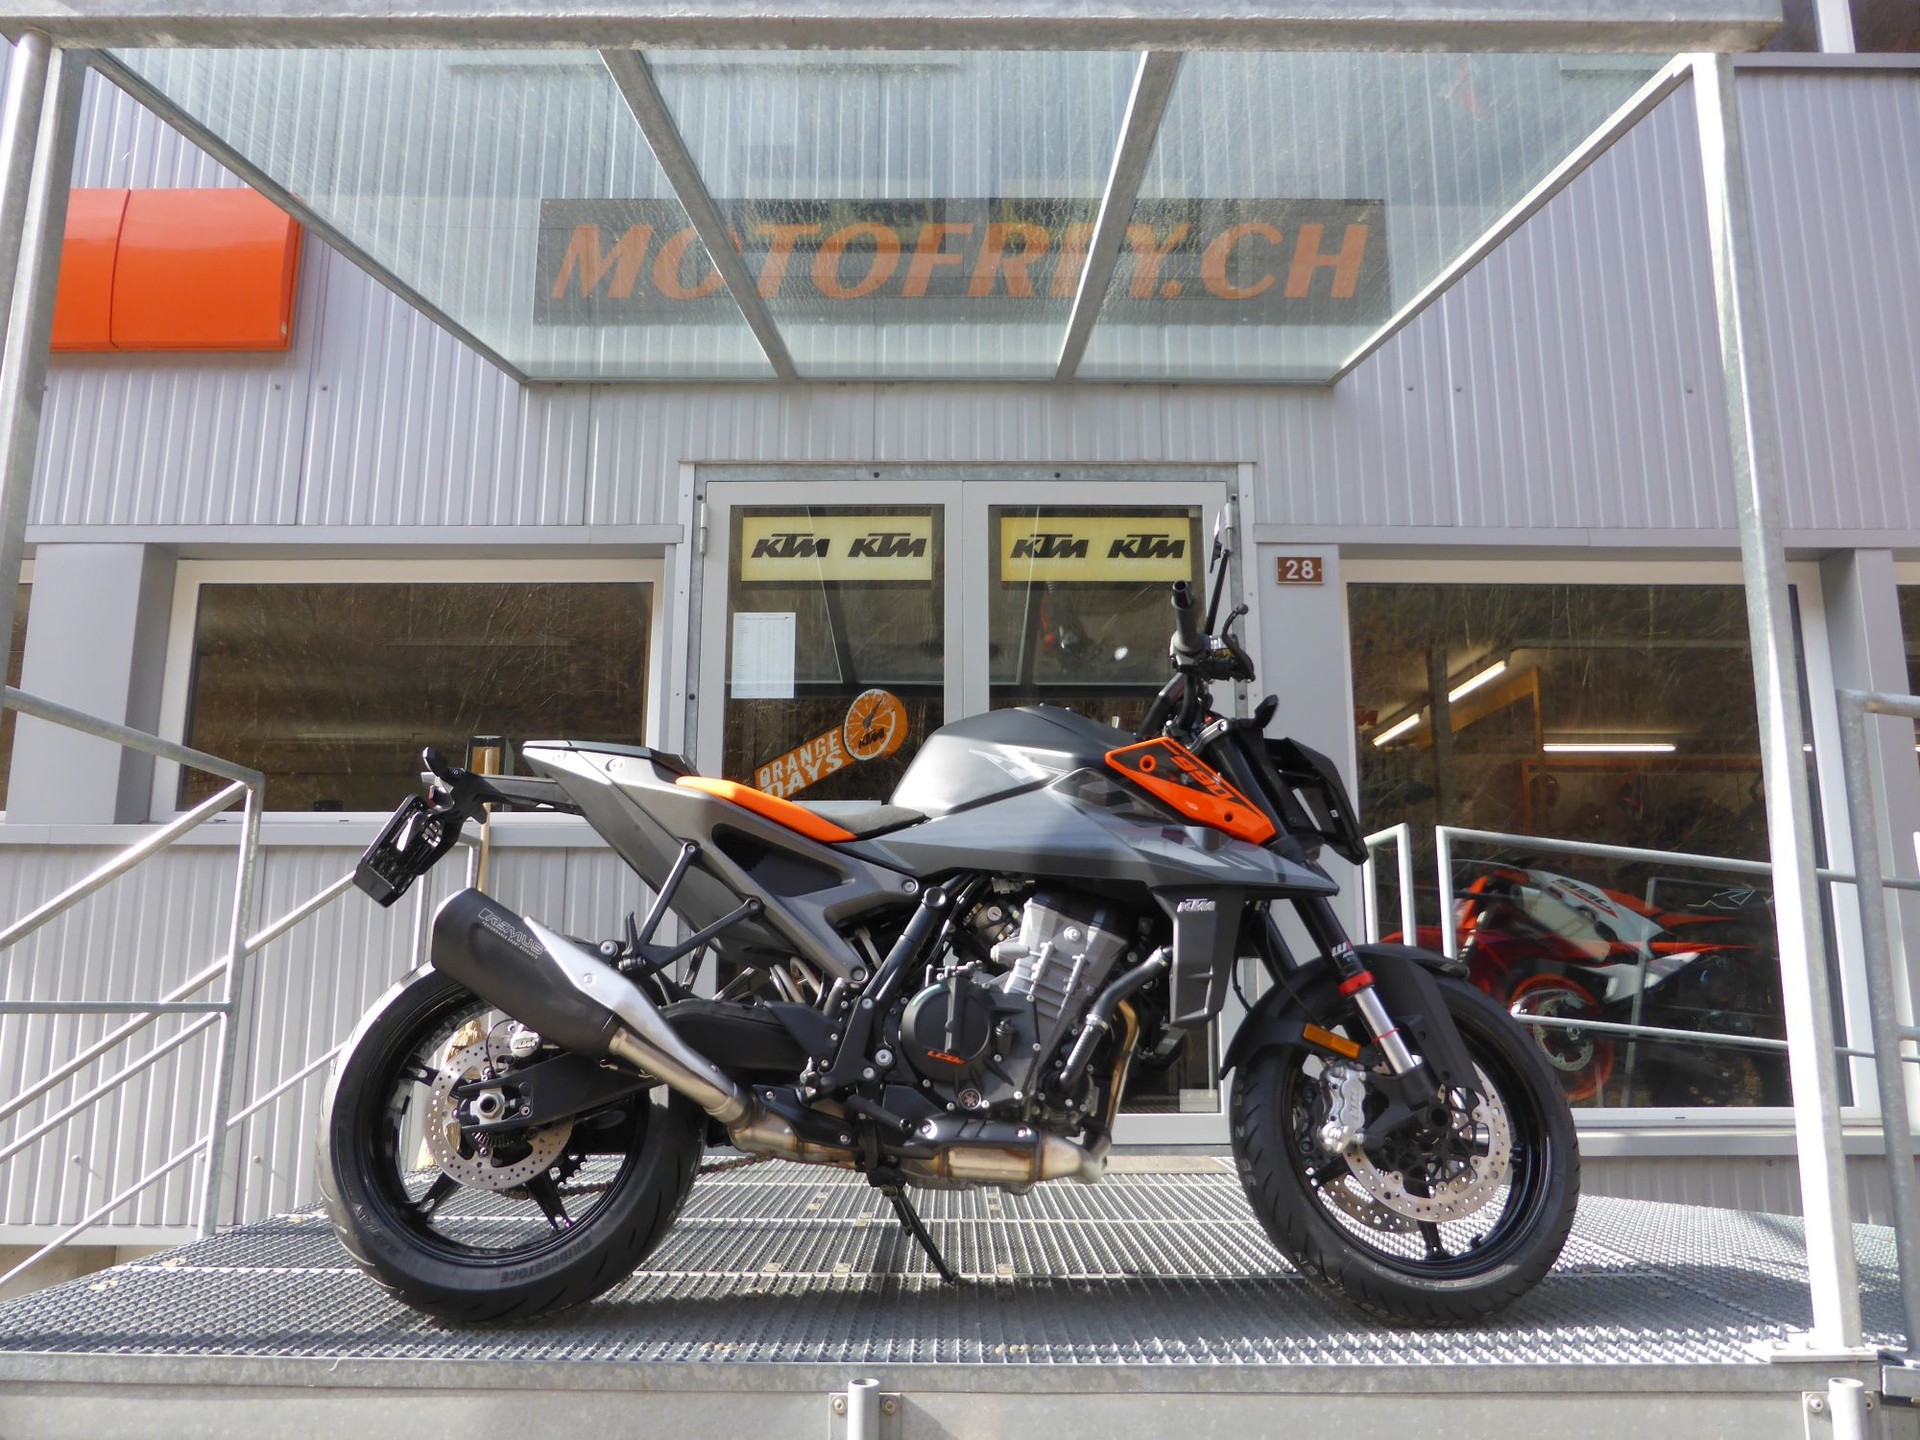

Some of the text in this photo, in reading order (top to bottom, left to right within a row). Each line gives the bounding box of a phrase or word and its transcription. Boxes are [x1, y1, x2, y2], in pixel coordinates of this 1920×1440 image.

[751, 533, 927, 558] KTM KTM
[1009, 534, 1185, 558] KTM KTM
[1286, 559, 1314, 580] 28
[759, 729, 840, 788] ORANGE
[1177, 898, 1216, 913] KTM
[484, 914, 545, 956] REMUS
